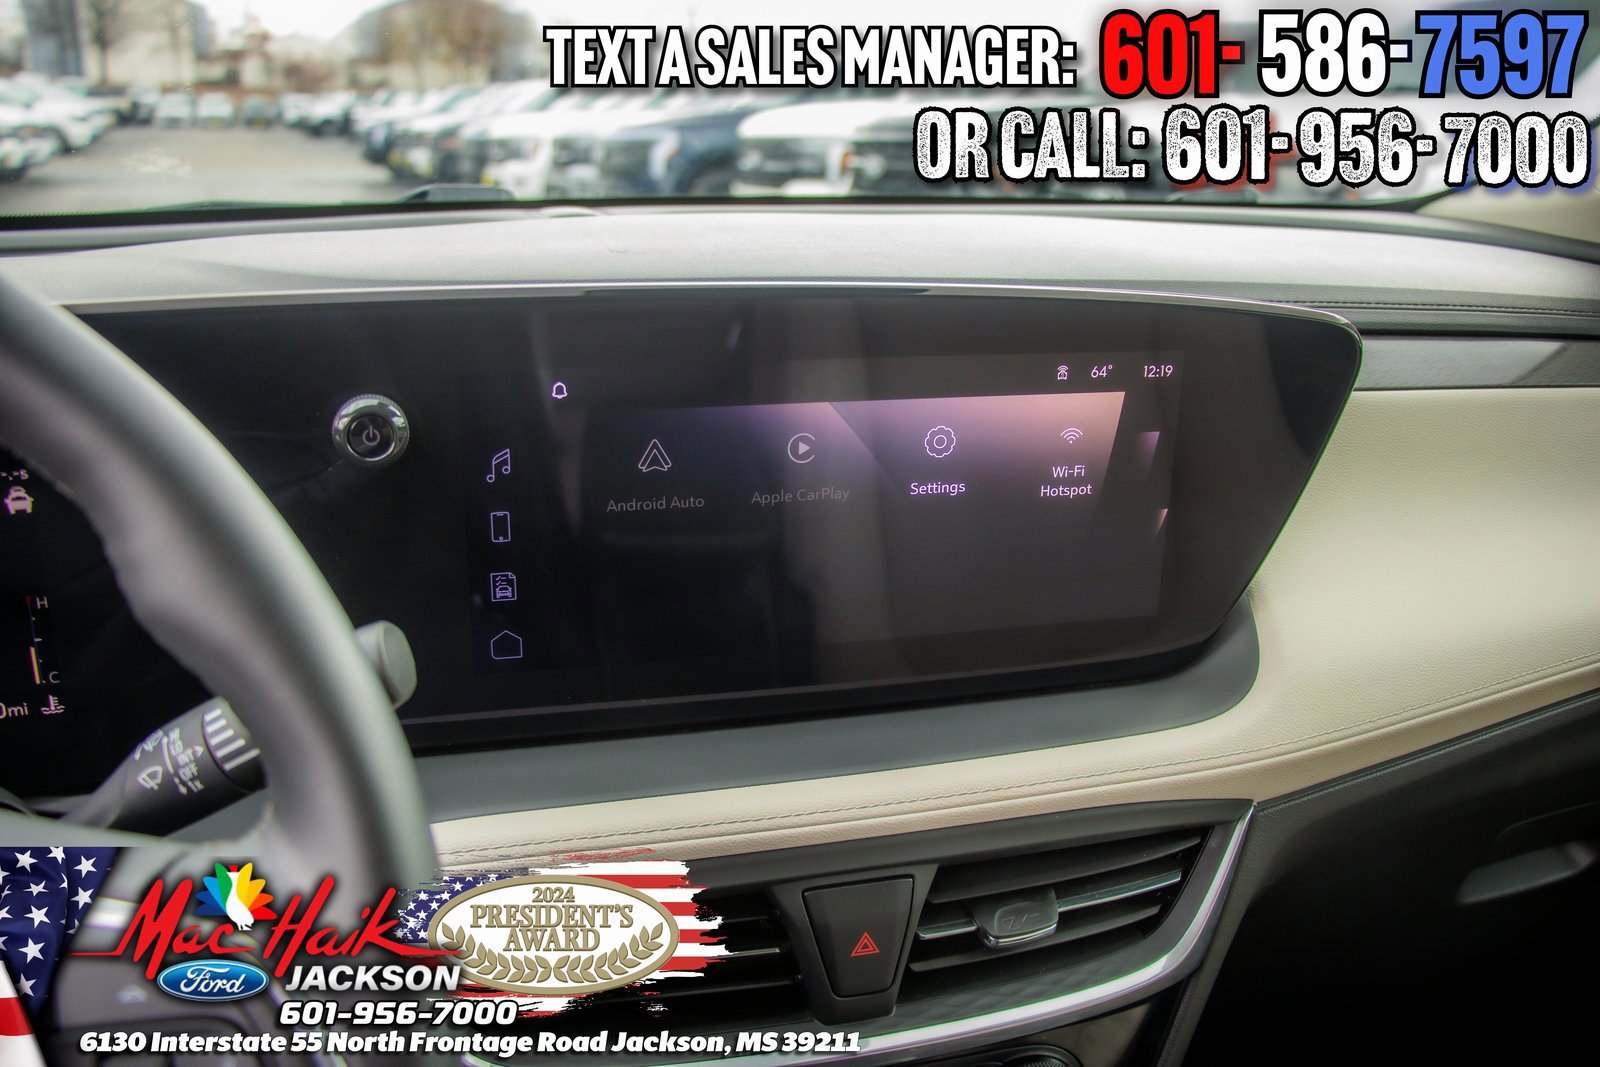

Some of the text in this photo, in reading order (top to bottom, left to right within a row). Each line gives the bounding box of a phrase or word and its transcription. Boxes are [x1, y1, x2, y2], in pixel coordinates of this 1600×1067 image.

[1143, 365, 1173, 378] 12:19
[1052, 465, 1085, 478] Wi-Fi
[910, 481, 966, 496] Settings
[1040, 483, 1092, 498] Hotspot
[751, 486, 850, 506] Apple CarPlay
[606, 495, 705, 512] Android Auto
[36, 597, 48, 609] H
[49, 671, 61, 683] C
